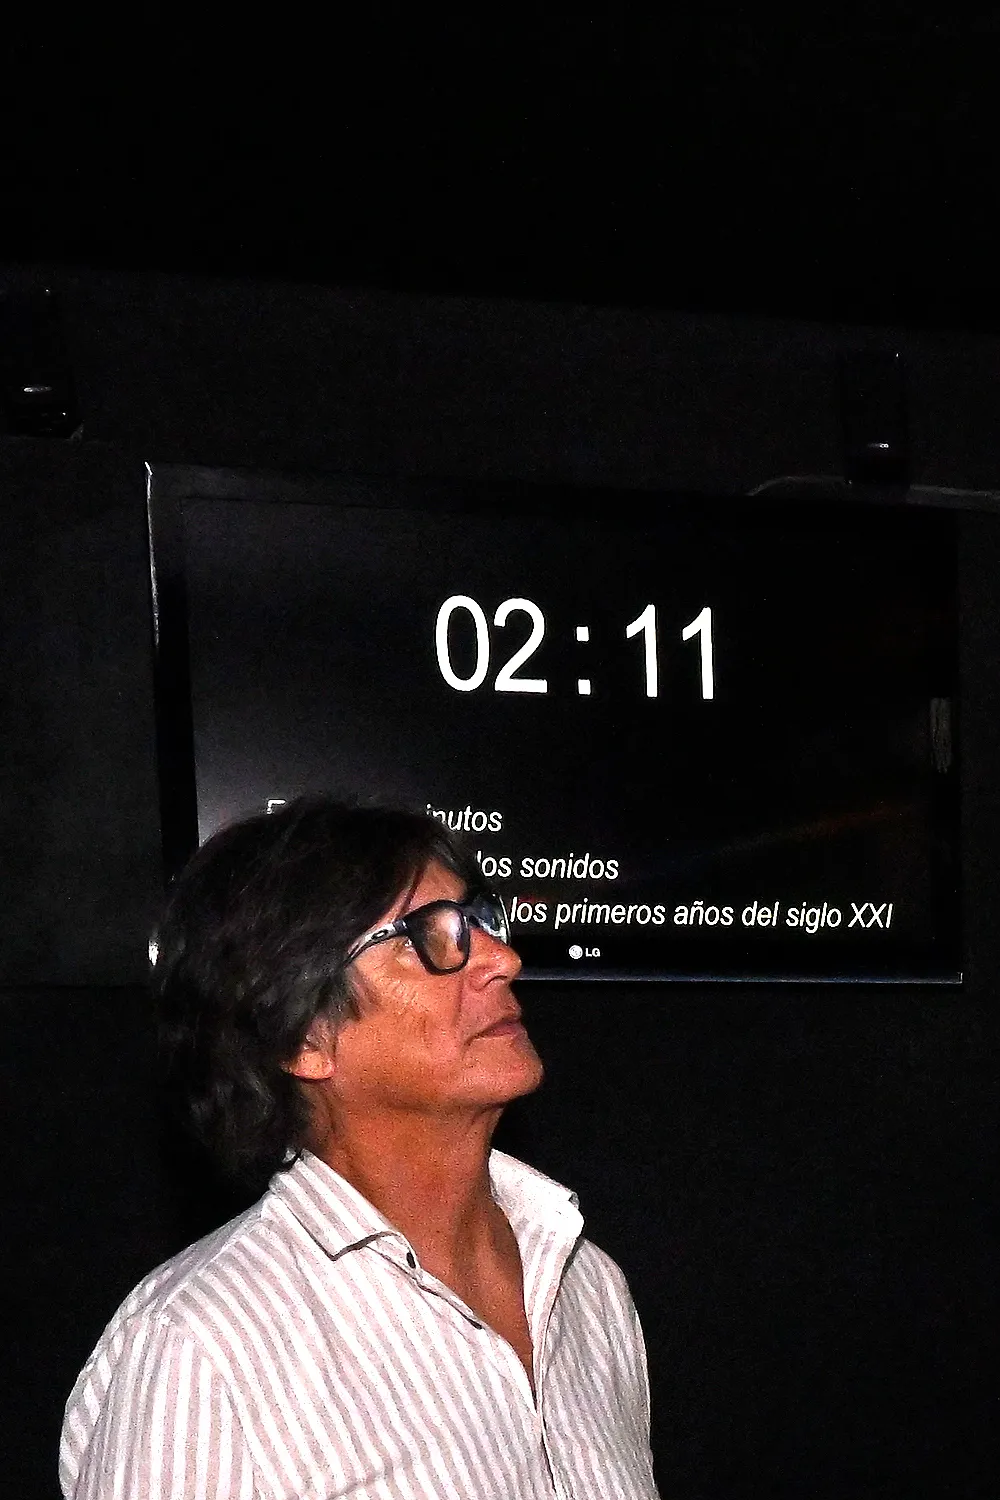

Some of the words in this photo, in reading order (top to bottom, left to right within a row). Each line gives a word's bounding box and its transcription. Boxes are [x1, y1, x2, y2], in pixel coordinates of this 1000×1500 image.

[519, 852, 619, 880] sonidos
[509, 896, 548, 923] los
[554, 897, 666, 930] primeros
[673, 900, 735, 926] años
[741, 900, 780, 927] del
[785, 901, 842, 934] siglo
[847, 902, 894, 929] XXI
[585, 947, 601, 958] LG
